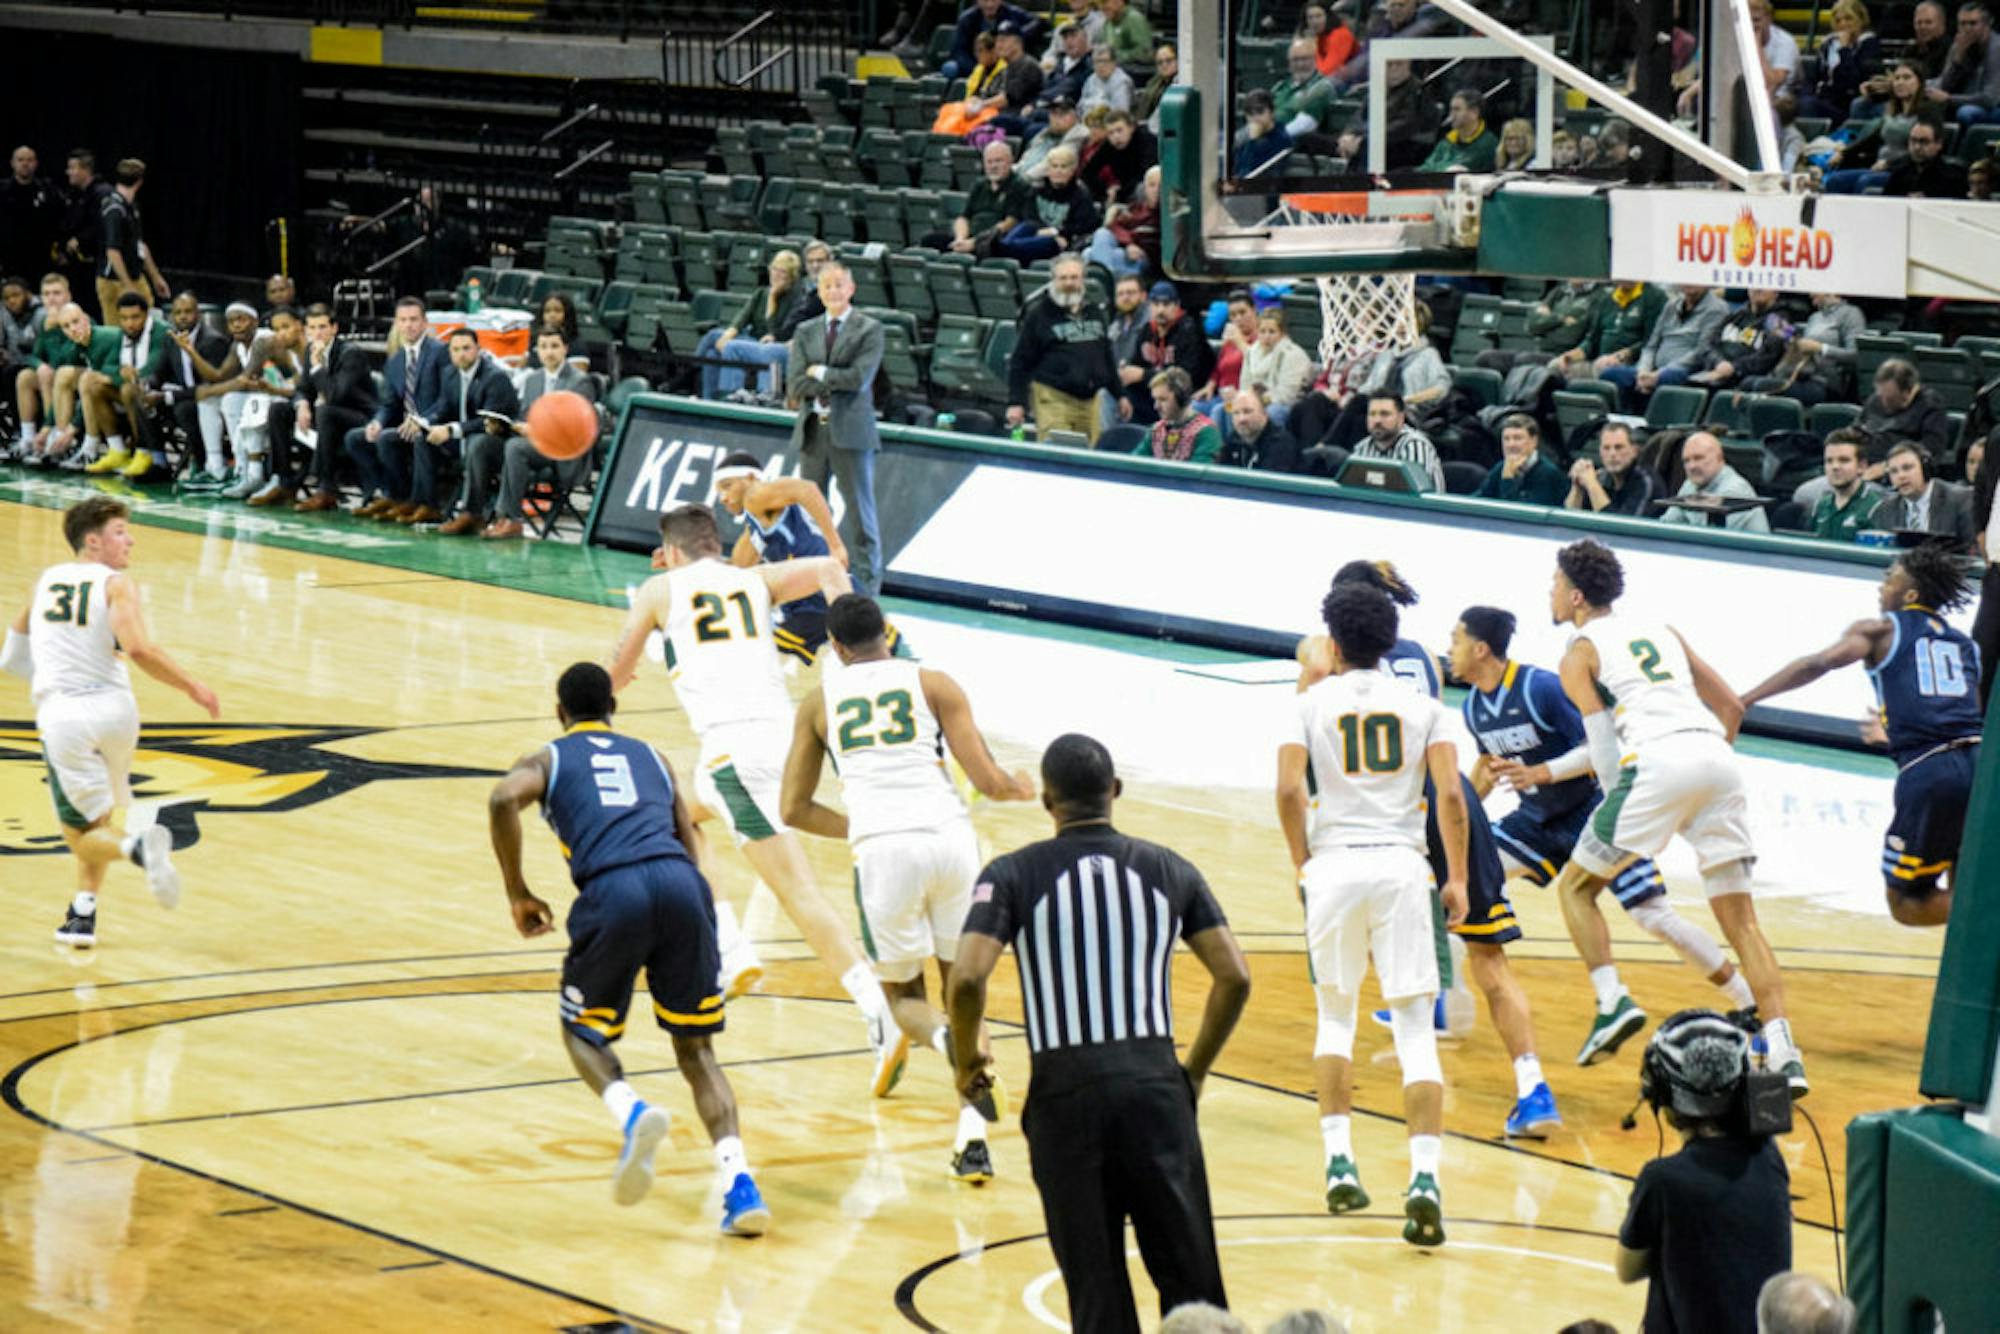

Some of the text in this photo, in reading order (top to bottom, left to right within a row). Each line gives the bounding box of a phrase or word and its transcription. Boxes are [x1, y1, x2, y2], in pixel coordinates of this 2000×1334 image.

[1677, 223, 1833, 270] HOT HEAD
[1712, 269, 1797, 288] BURRITOS
[43, 580, 94, 627] 31
[692, 590, 757, 643] 21
[1628, 639, 1675, 684] 2
[1915, 636, 1968, 697] 10
[836, 689, 918, 755] 23
[1338, 712, 1403, 776] 10
[590, 752, 639, 808] 3
